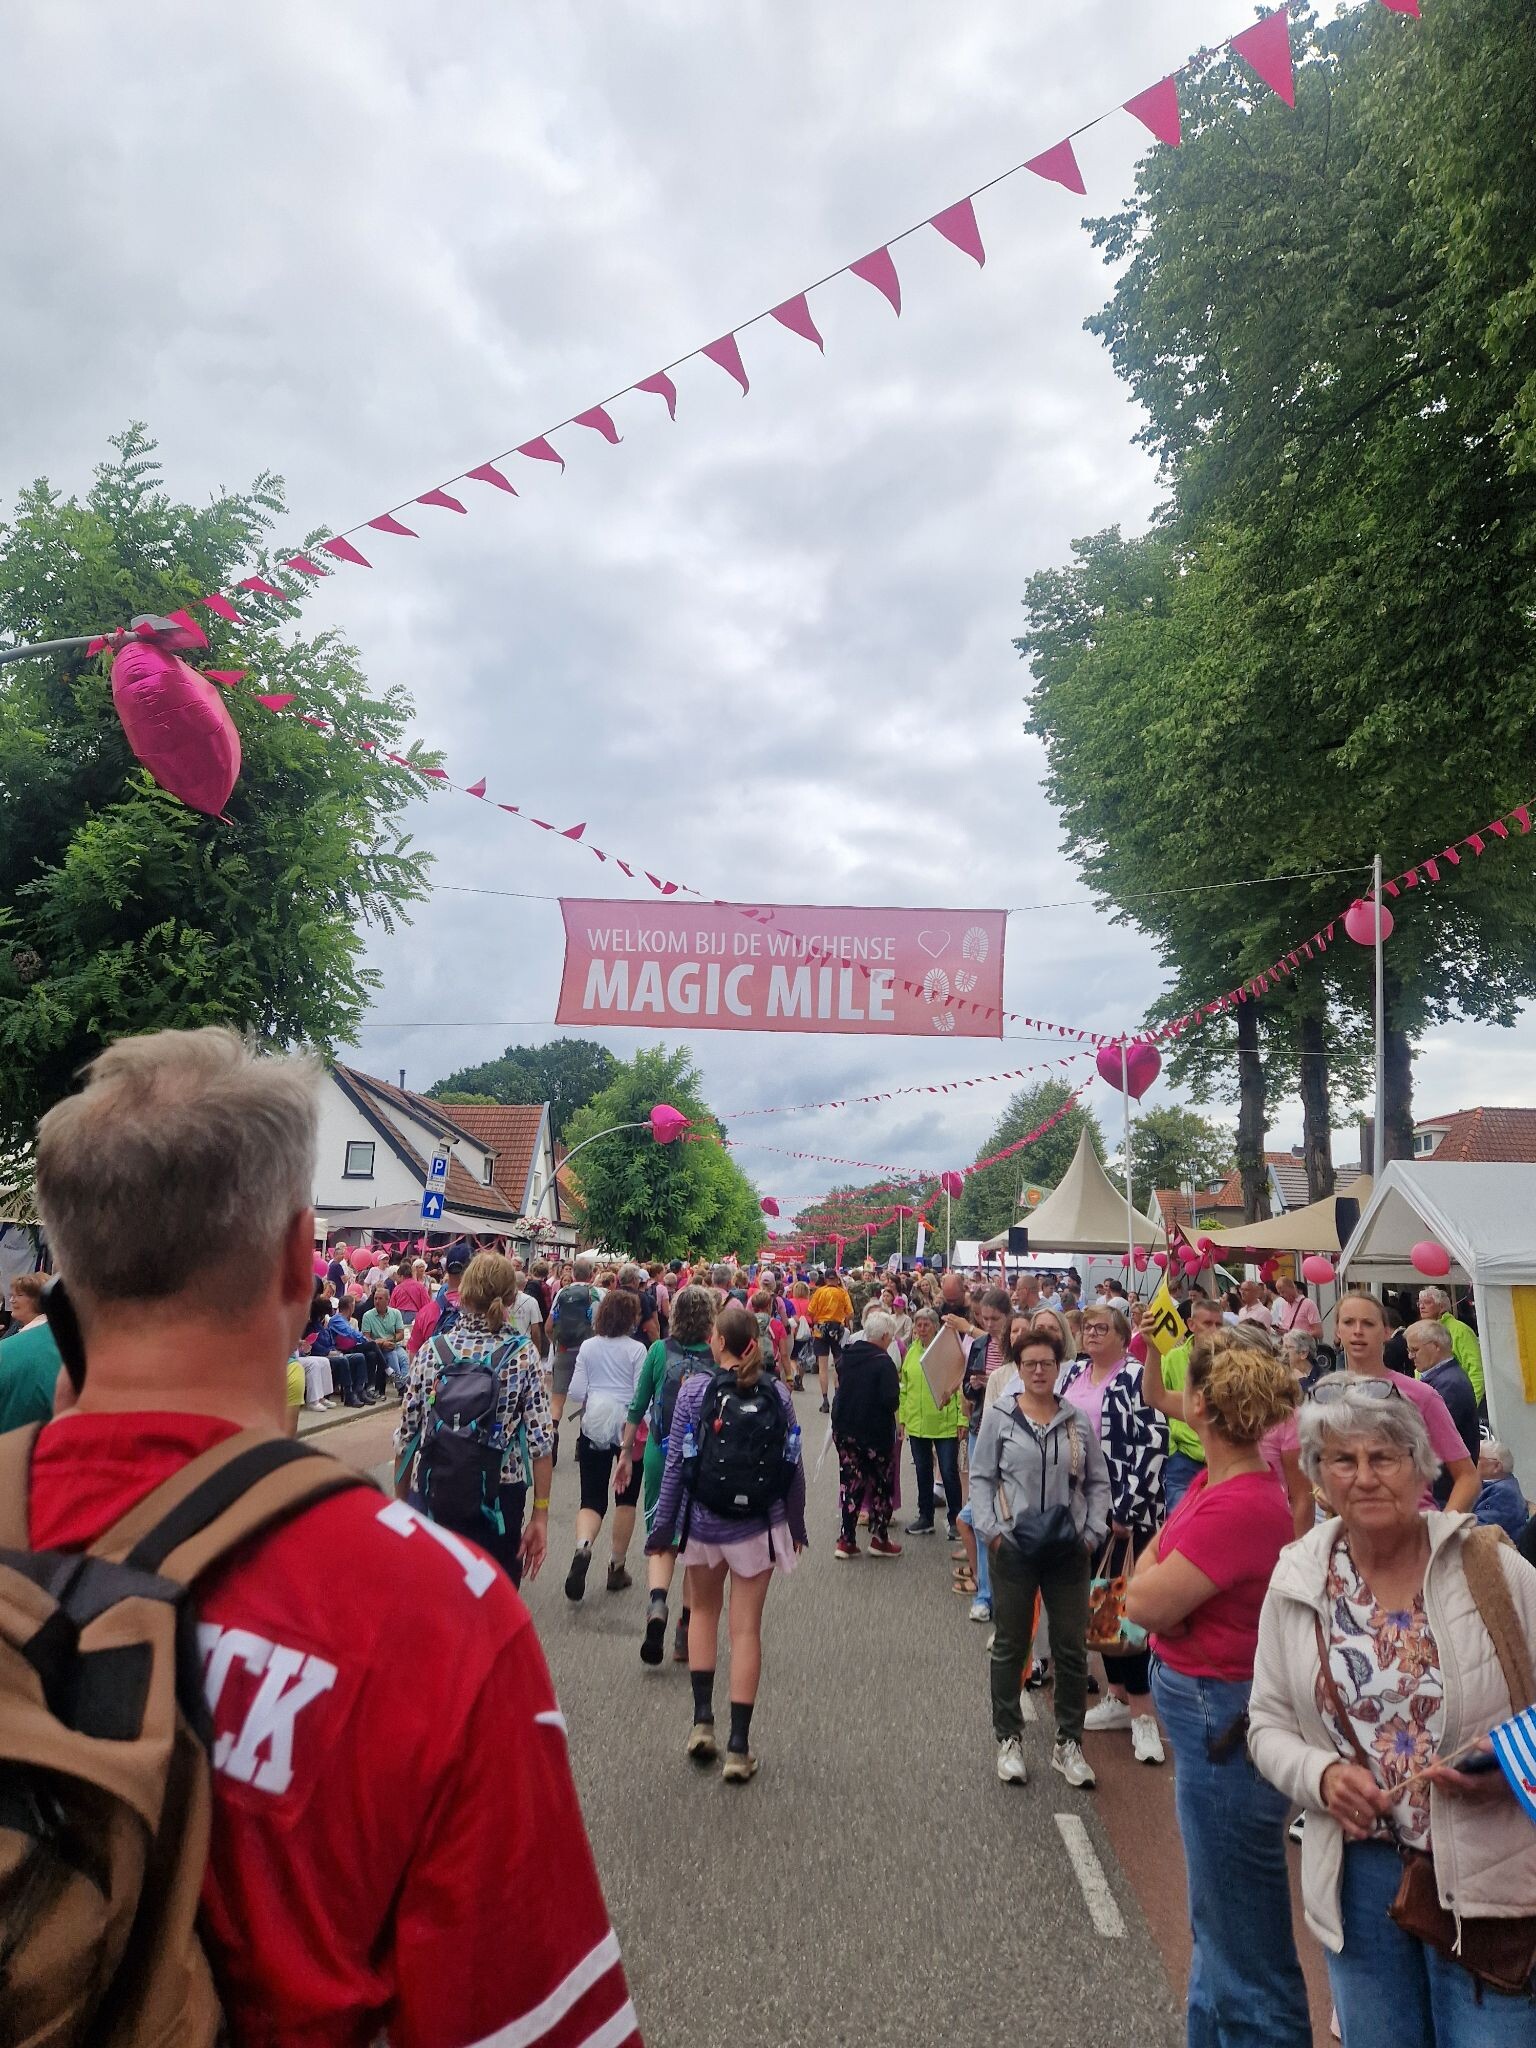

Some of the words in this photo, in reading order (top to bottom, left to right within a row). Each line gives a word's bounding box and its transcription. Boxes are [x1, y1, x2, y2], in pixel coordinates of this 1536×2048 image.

[587, 928, 688, 954] WELKOM
[695, 931, 726, 955] BIJ
[734, 933, 762, 957] DE
[767, 934, 896, 961] WIJCHENSE
[582, 958, 755, 1016] MAGIC
[766, 965, 896, 1021] MILE
[435, 1160, 444, 1173] P
[375, 1498, 497, 1599] 7
[197, 1621, 339, 1796] CK
